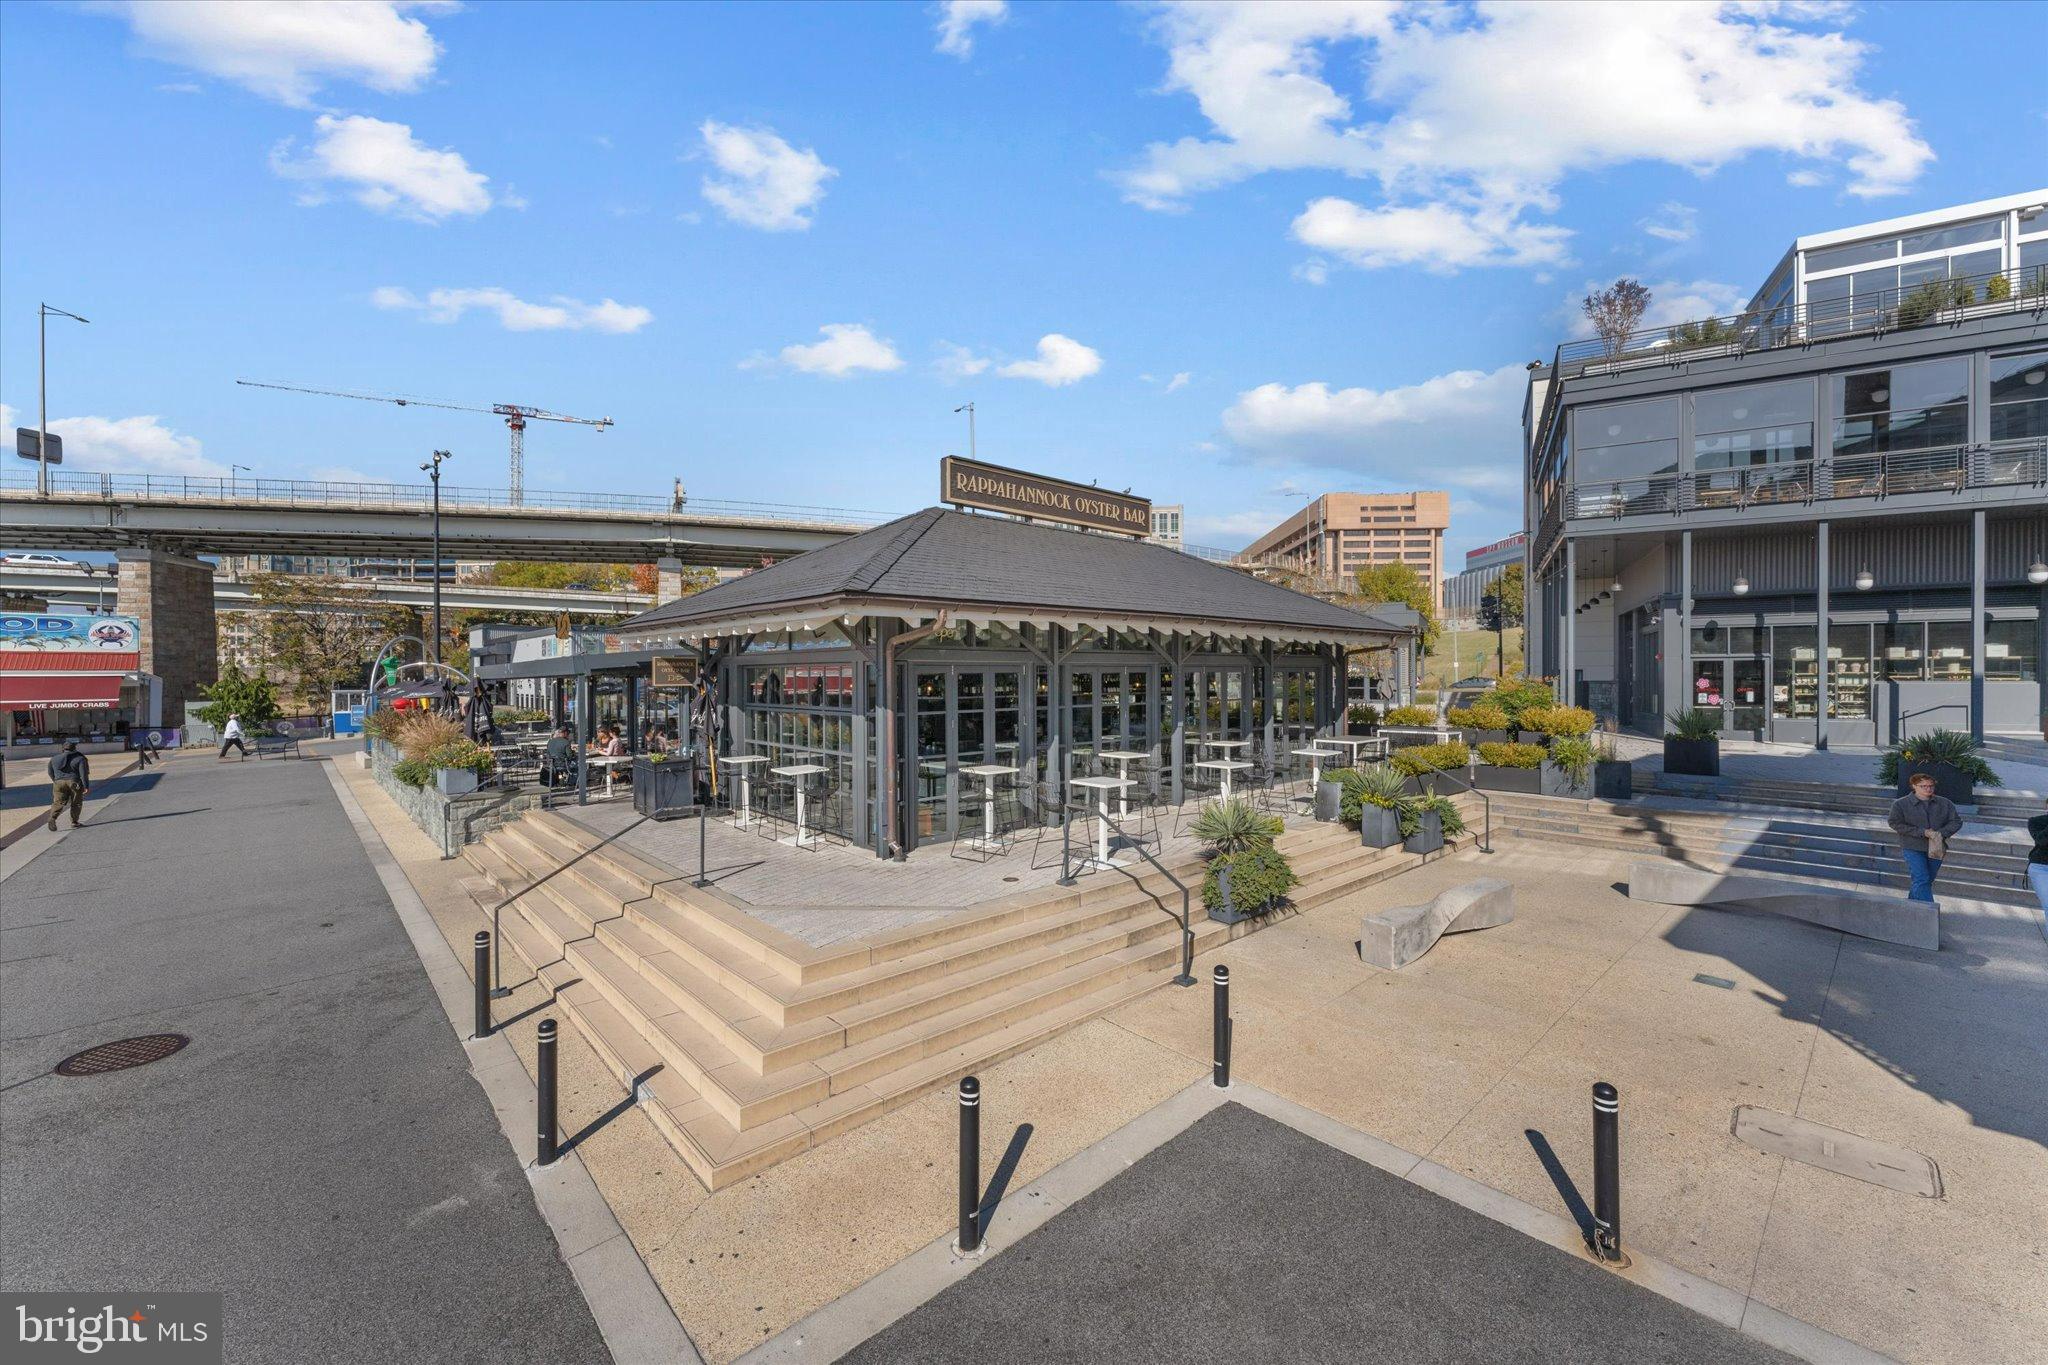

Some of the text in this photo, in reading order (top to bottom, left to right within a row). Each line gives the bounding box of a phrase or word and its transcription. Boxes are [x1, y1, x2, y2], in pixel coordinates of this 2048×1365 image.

[956, 472, 1146, 526] RAPPAHANNOCK OYSTER BAR
